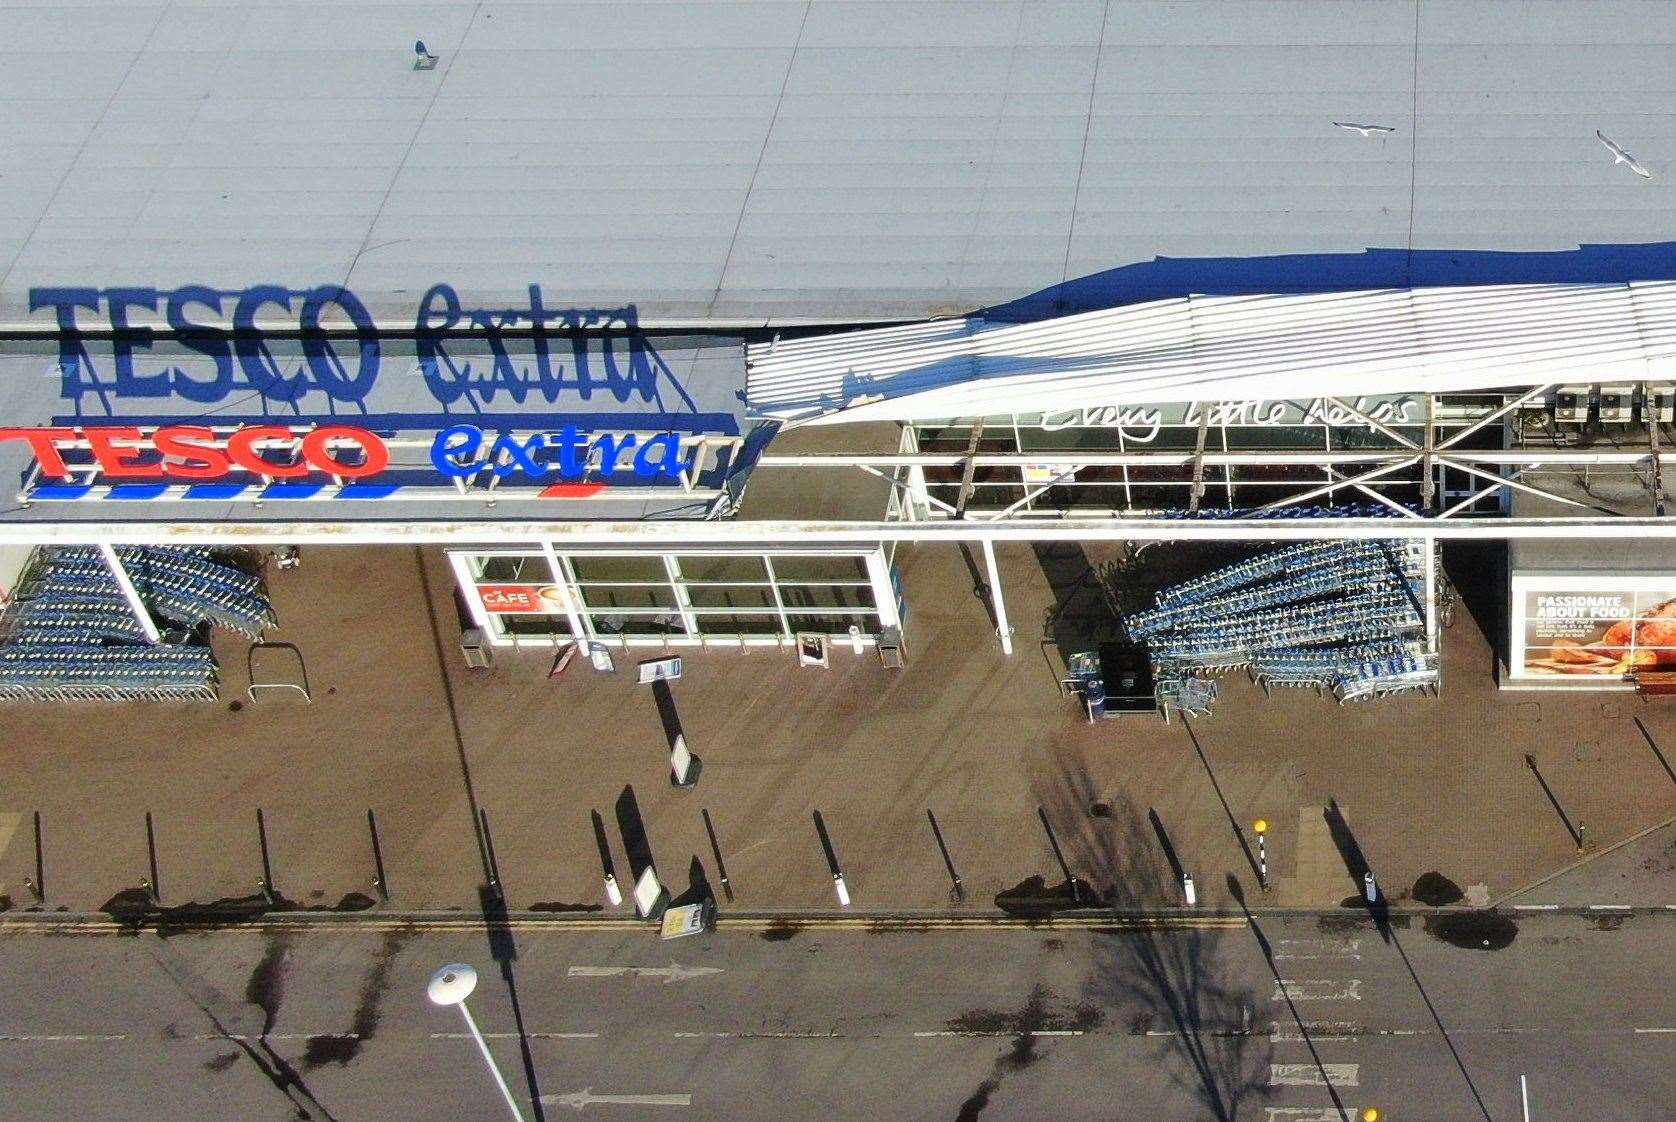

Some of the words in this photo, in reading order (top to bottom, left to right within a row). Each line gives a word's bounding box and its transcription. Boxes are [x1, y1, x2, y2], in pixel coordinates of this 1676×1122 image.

[1040, 406, 1161, 442] Every
[0, 425, 389, 477] TESCO
[430, 424, 690, 477] extra
[1536, 607, 1586, 618] ABOUT
[1590, 607, 1630, 618] FOOD
[1537, 596, 1622, 607] PASSIONATE
